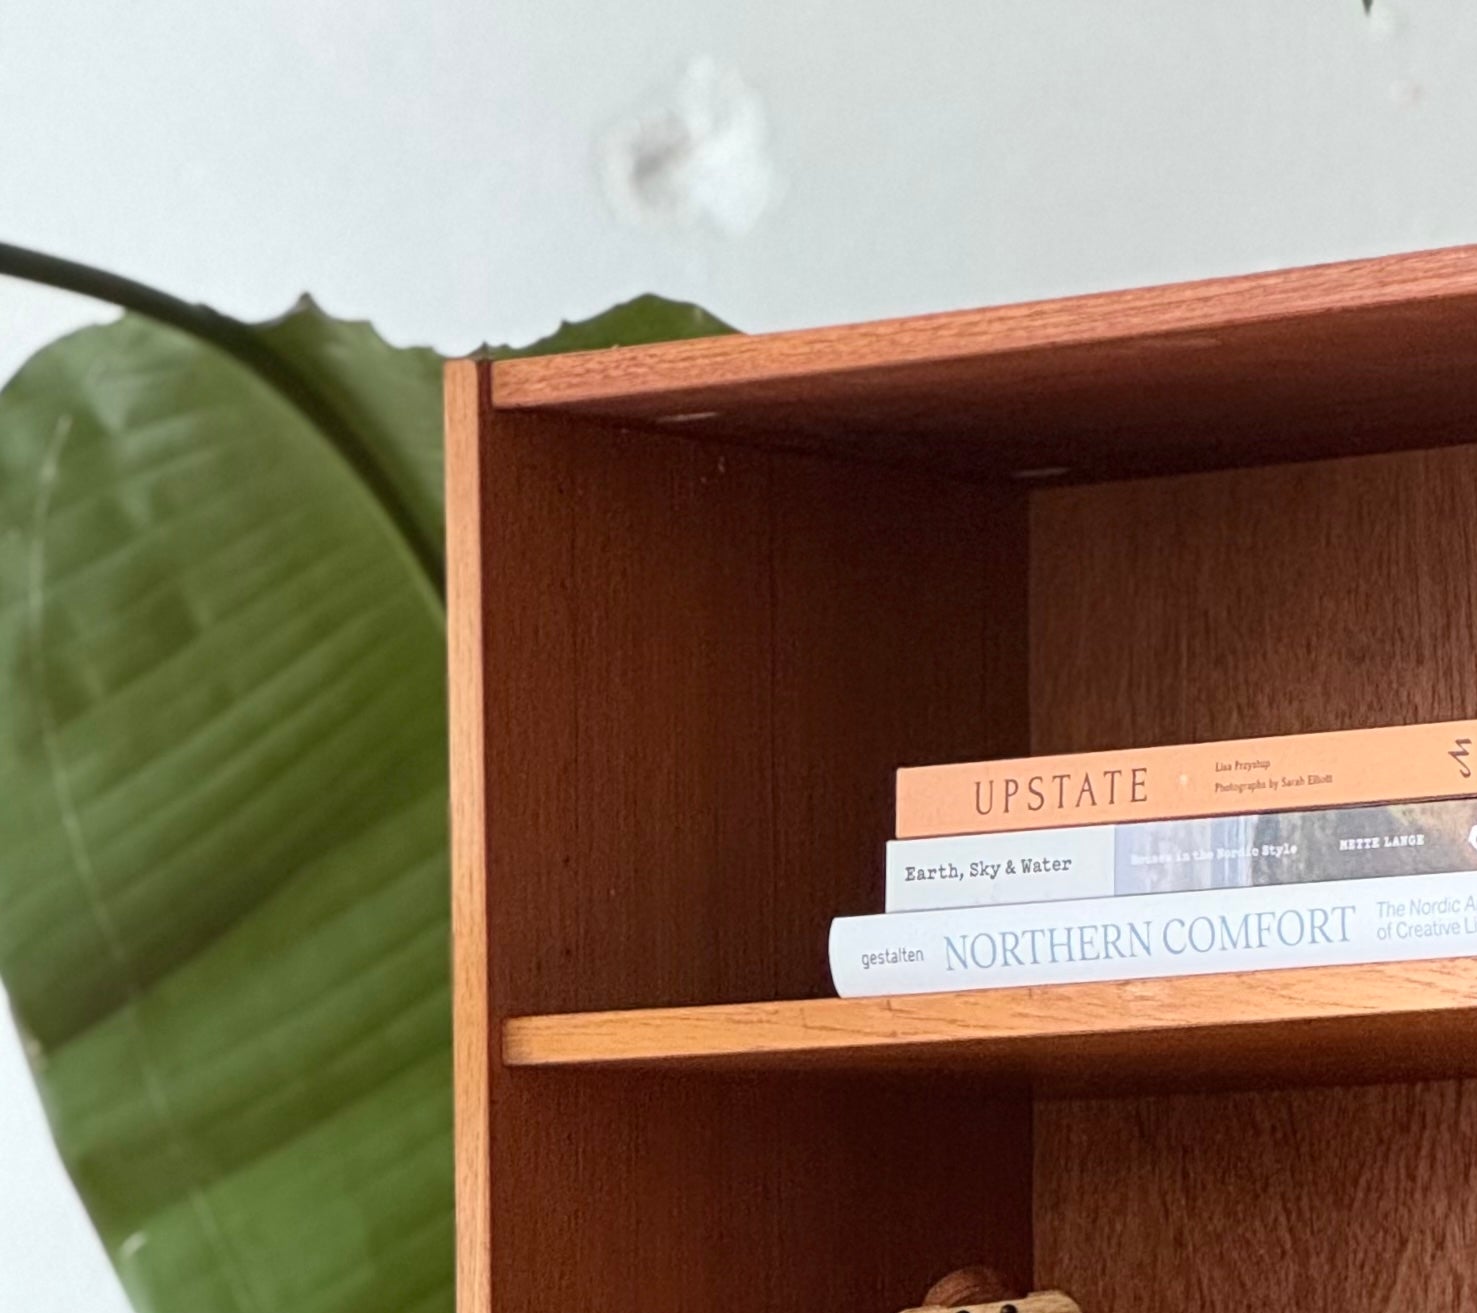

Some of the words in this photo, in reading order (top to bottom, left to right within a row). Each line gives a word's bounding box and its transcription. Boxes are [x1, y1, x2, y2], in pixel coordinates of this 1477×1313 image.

[974, 767, 1148, 815] UPSTATE
[1214, 779, 1267, 794] Photographs
[1269, 778, 1279, 791] by
[1281, 775, 1305, 788] Sarah
[1192, 848, 1214, 861] the
[1216, 845, 1259, 860] Nordic
[1261, 842, 1298, 858] Style
[1339, 835, 1380, 851] METTE
[1383, 833, 1425, 848] LANGE
[905, 864, 964, 883] Earth,
[969, 860, 1001, 880] Sky
[1005, 860, 1016, 875] &
[1021, 857, 1072, 874] Water
[1377, 900, 1406, 919] The
[1409, 897, 1460, 917] Nordic
[944, 921, 1153, 971] NORTHERN
[1162, 905, 1356, 955] COMFORT
[1377, 923, 1394, 941] of
[1396, 919, 1461, 940] Creative
[861, 947, 924, 969] gestalten
